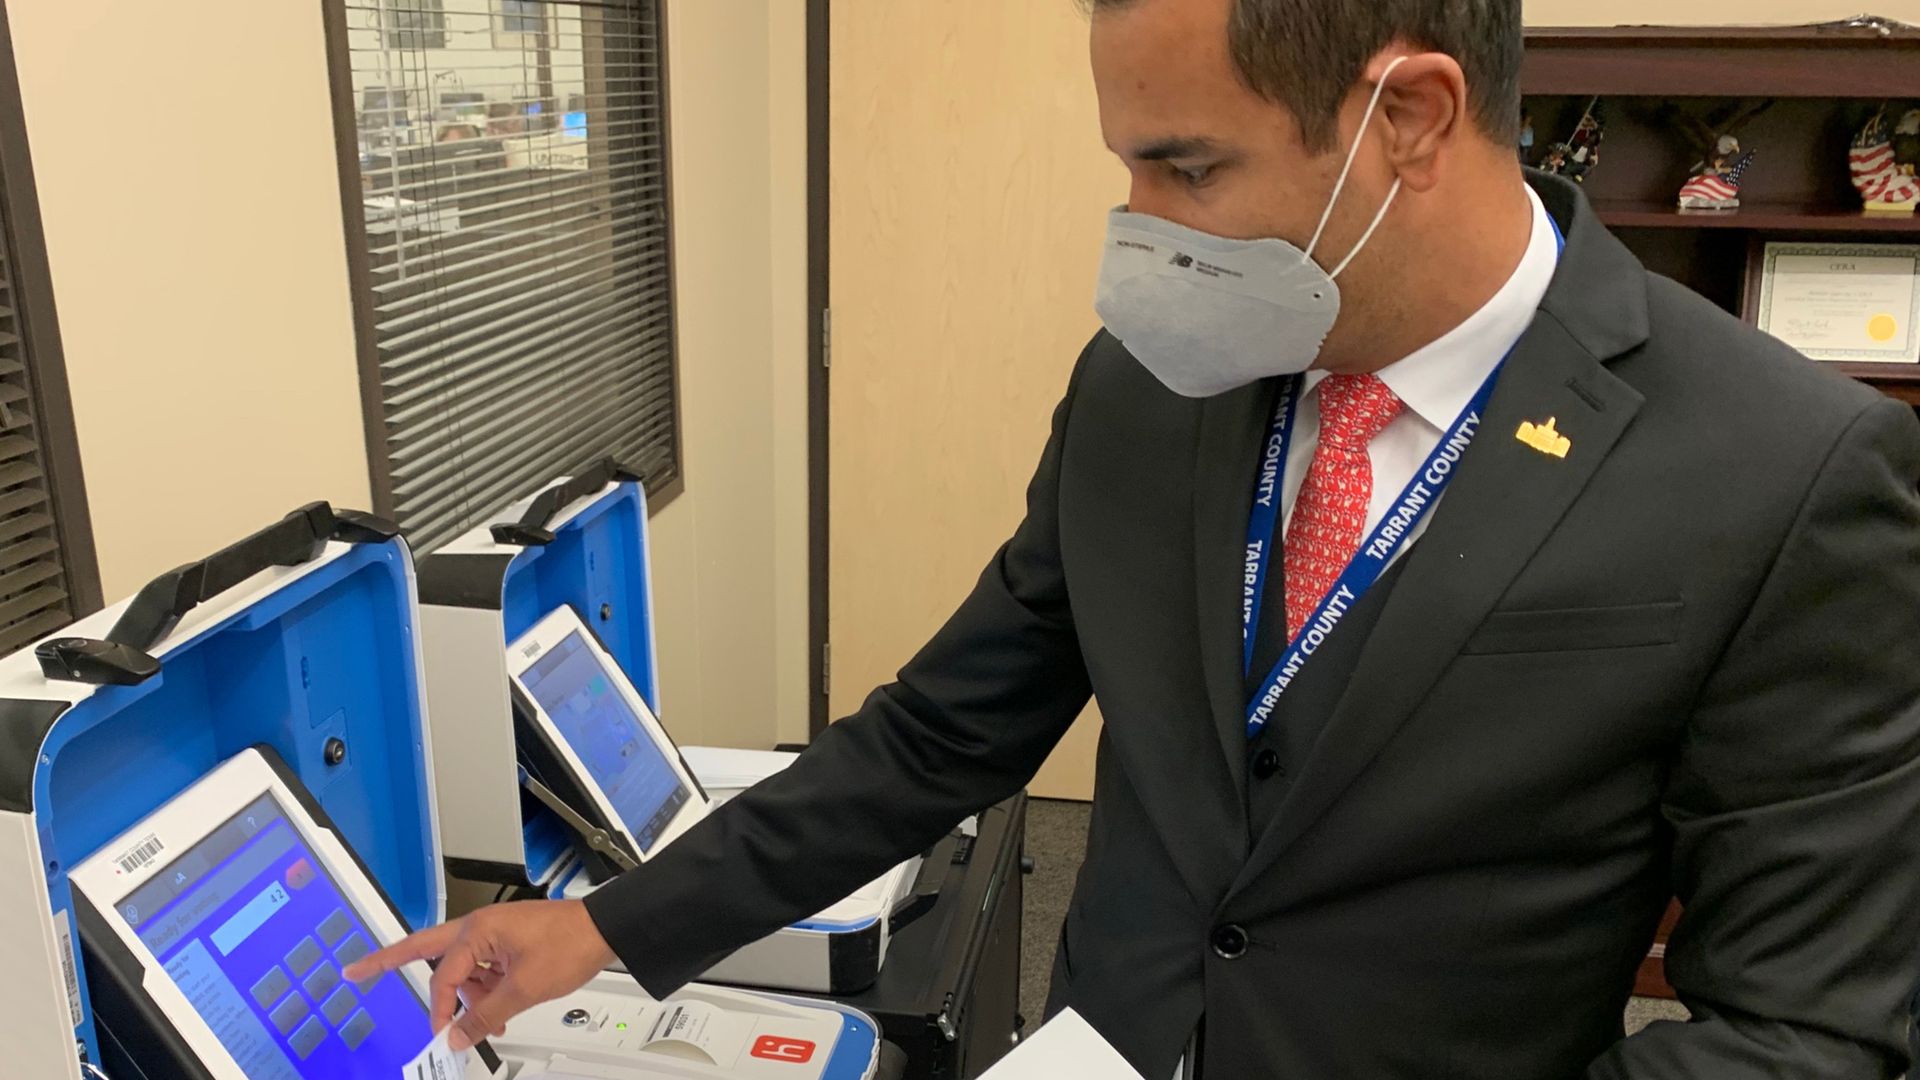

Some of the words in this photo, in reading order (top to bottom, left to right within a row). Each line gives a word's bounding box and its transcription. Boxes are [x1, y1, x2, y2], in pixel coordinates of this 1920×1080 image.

[1256, 434, 1282, 507] COUNTY
[1366, 483, 1434, 561] TARRANT
[1425, 410, 1482, 487] COUNTY
[1249, 652, 1305, 727] TARRANT
[1301, 584, 1356, 655] COUNTY
[151, 923, 180, 948] Ready
[176, 911, 190, 927] for
